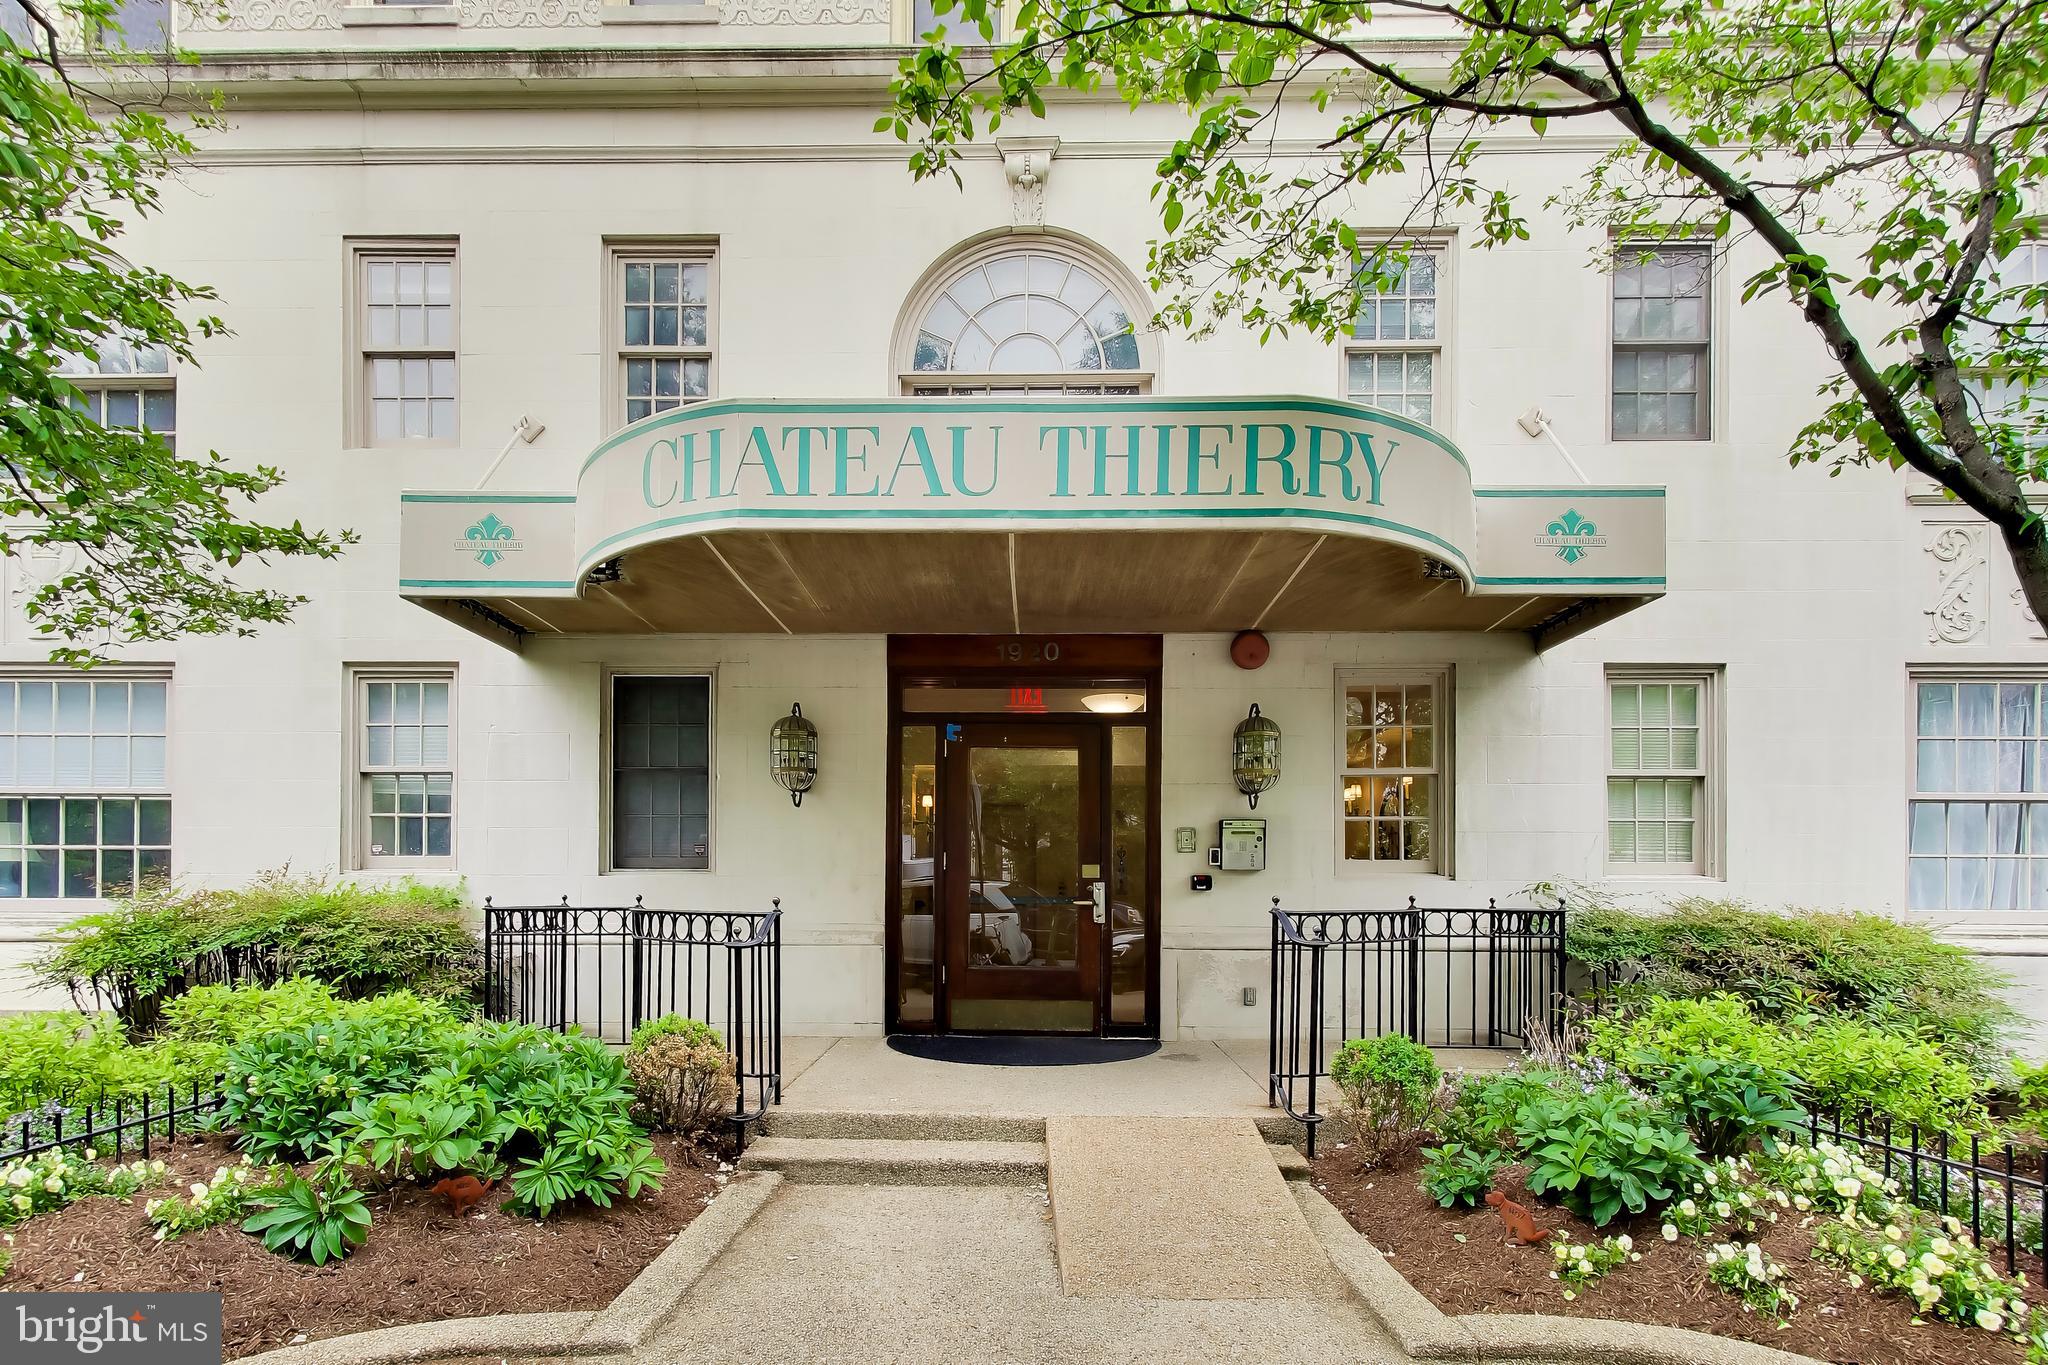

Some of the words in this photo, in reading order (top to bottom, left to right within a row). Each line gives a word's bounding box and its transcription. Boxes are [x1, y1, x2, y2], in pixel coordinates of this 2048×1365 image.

[642, 425, 1004, 509] CHATEAU
[1039, 423, 1401, 507] THIERRY
[996, 641, 1060, 662] 1920
